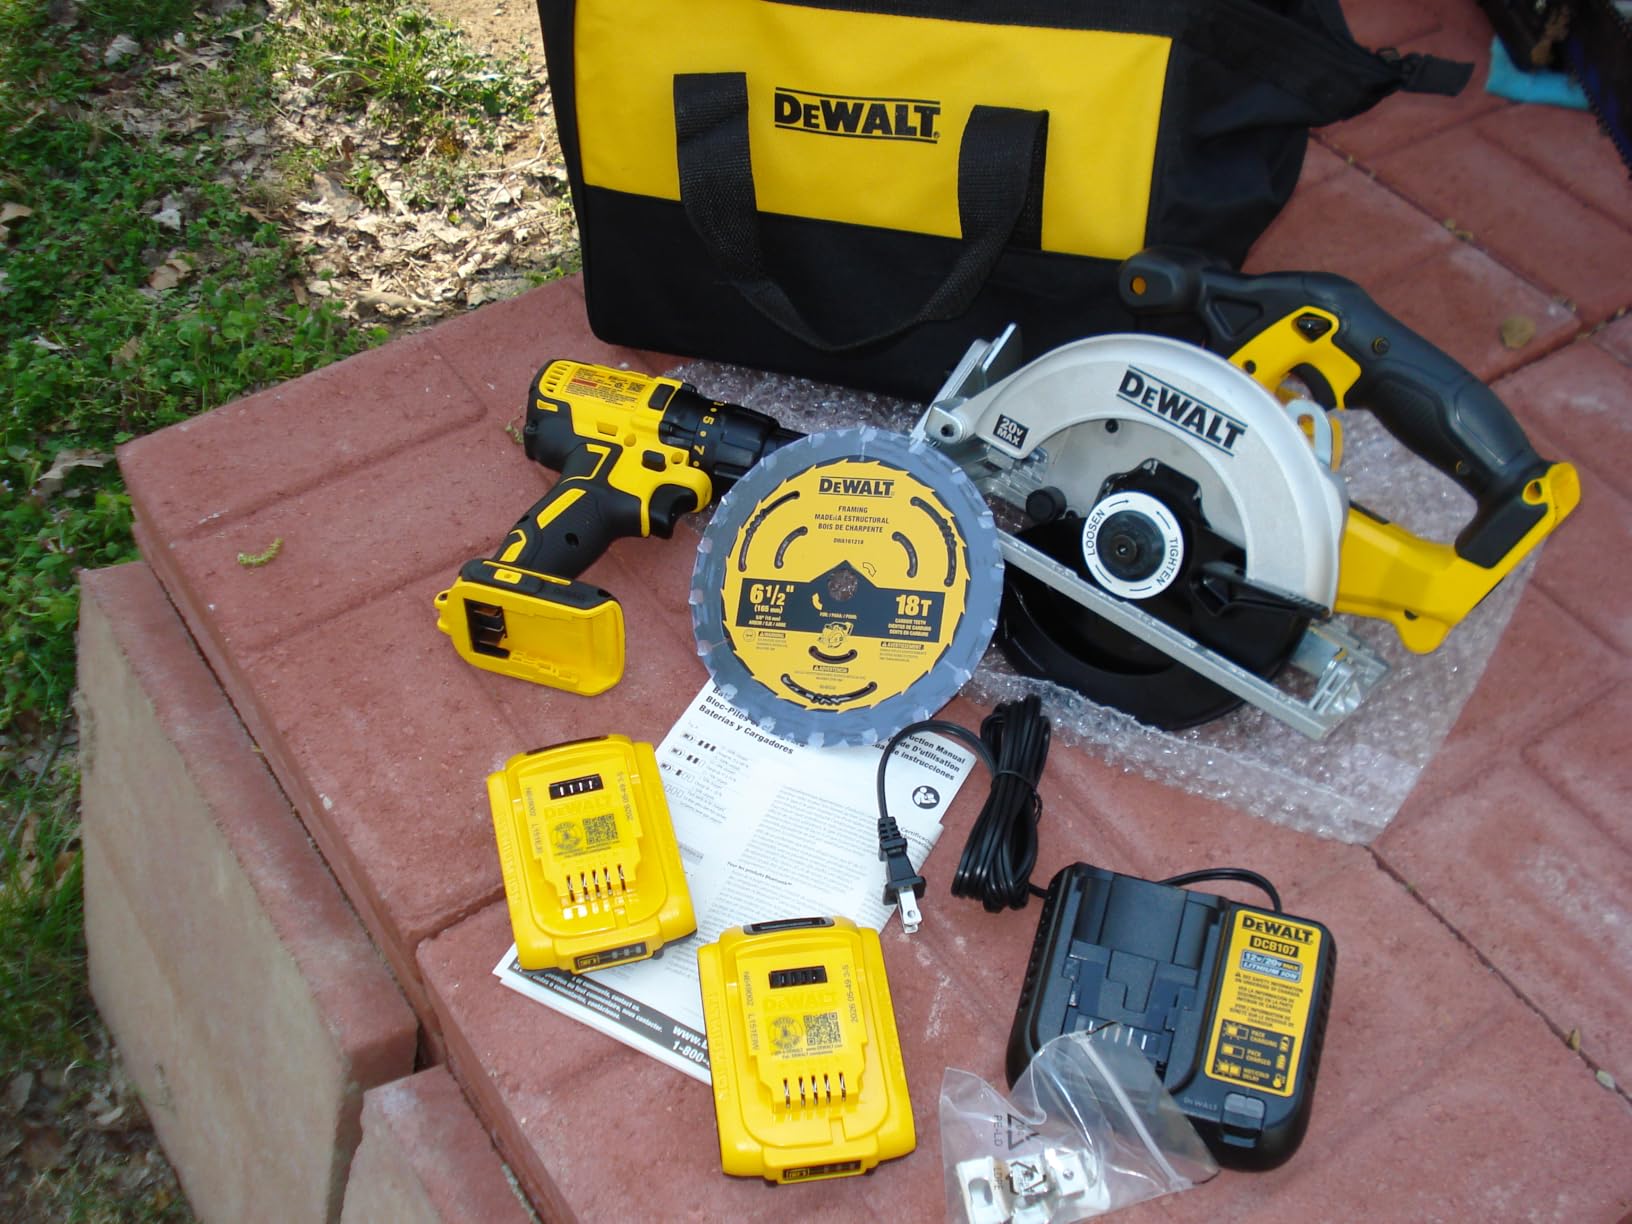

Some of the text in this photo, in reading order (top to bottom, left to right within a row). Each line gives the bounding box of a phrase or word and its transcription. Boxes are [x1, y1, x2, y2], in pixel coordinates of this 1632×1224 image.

[775, 90, 940, 139] DEWALT
[1118, 368, 1246, 450] DEWALT
[996, 427, 1021, 447] MAX
[819, 478, 894, 496] DEWALT
[838, 505, 868, 513] FRAMING
[844, 515, 889, 524] ESTRUCTURAL
[845, 524, 883, 533] CHARPENTE
[1086, 509, 1106, 556] LOOSEN
[1156, 536, 1179, 586] TIGHTEN
[736, 724, 743, 732] y
[744, 727, 794, 756] Cargadores
[901, 751, 955, 781] instrucciones
[912, 745, 960, 773] D'utilisation
[935, 745, 966, 765] Manual
[1242, 916, 1313, 943] DEWALT
[1253, 937, 1296, 956] DCB107
[1243, 962, 1299, 980] LITHIUM ION
